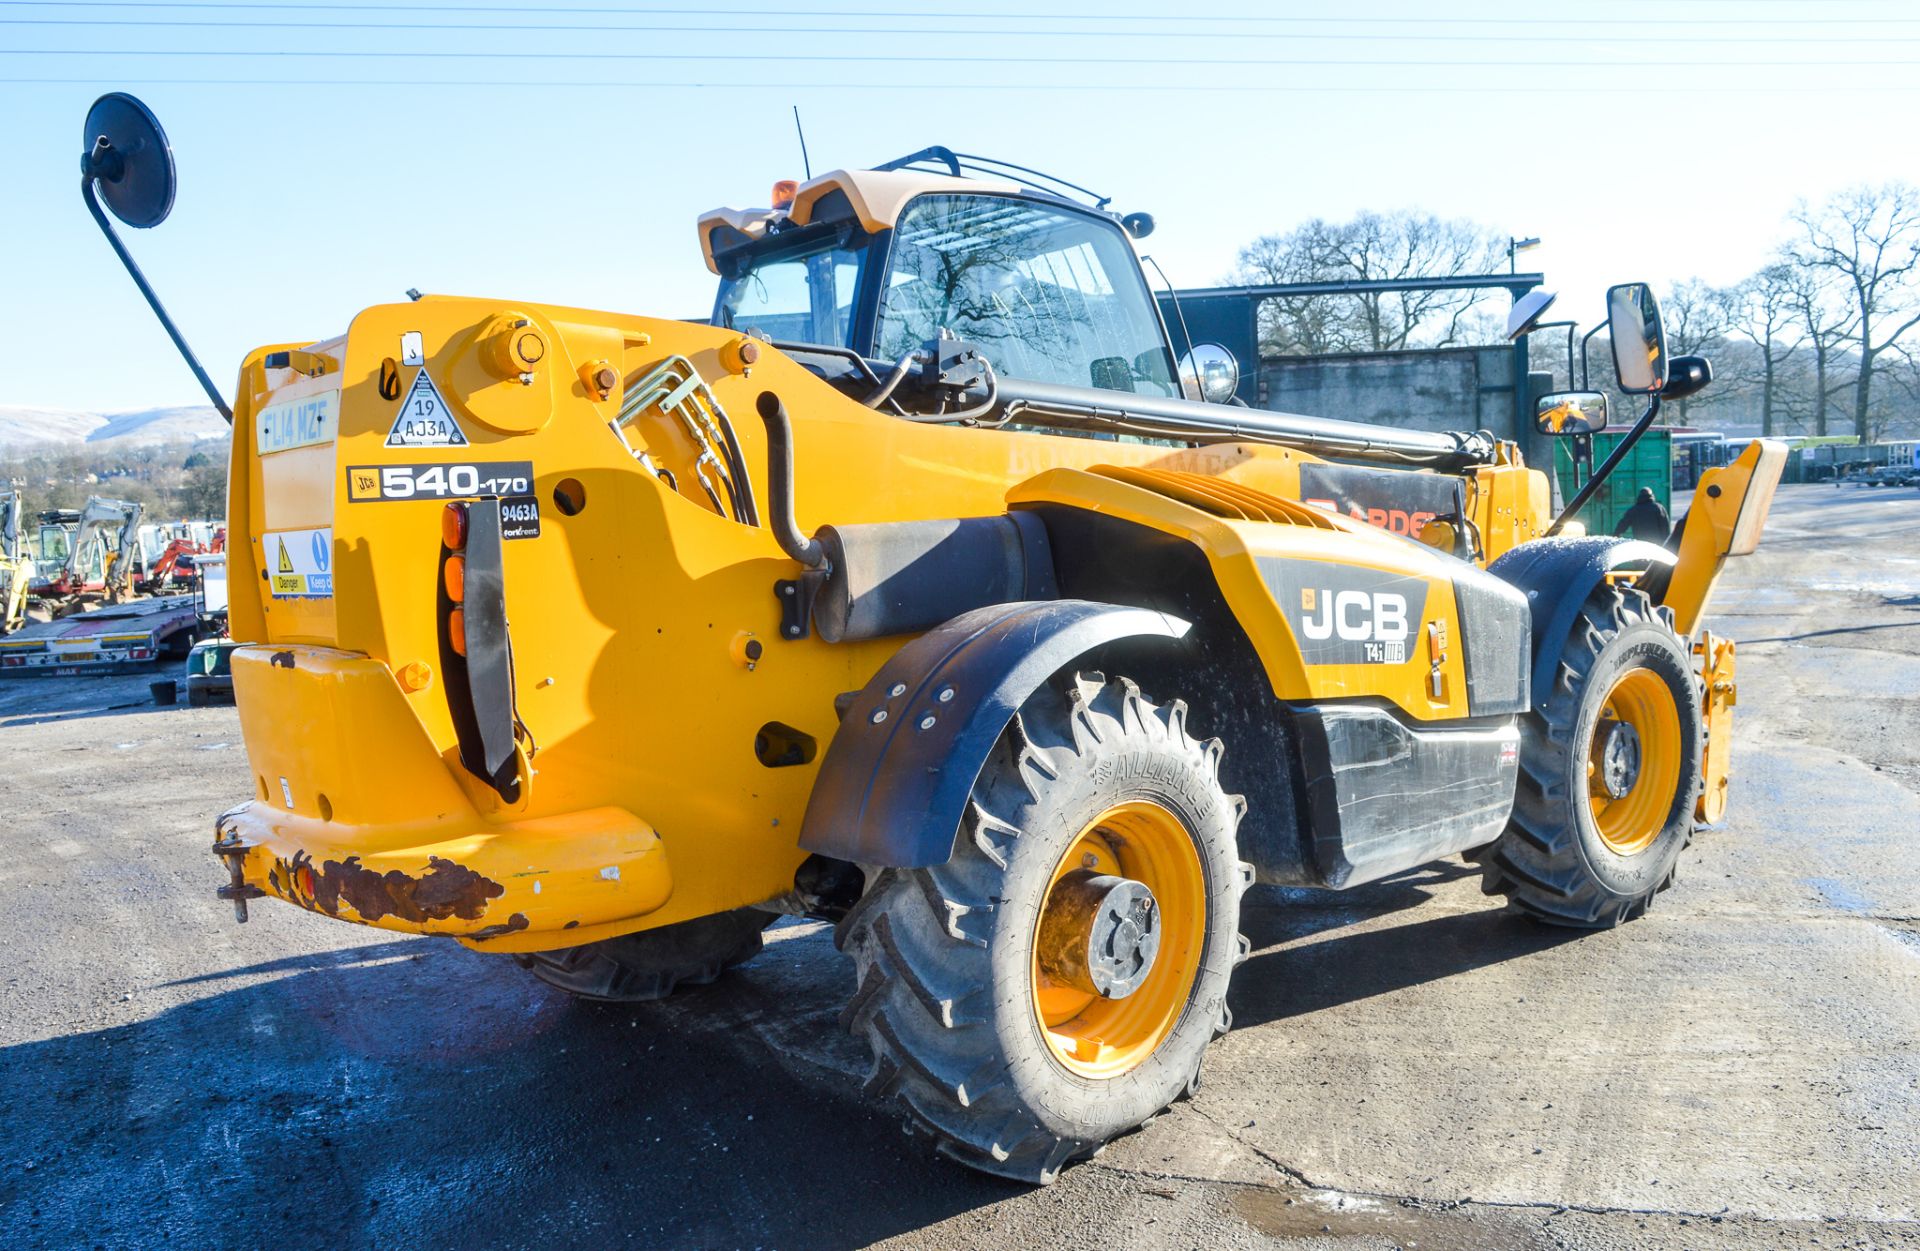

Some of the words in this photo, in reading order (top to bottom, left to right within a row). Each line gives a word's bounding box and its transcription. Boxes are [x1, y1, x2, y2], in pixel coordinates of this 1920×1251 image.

[414, 400, 434, 416] 19
[405, 420, 447, 436] AJ3A
[359, 476, 375, 490] JCB
[502, 503, 538, 521] 9463A
[279, 576, 298, 591] Danger
[1302, 589, 1409, 640] JCB
[1113, 752, 1216, 820] ALLIANCE
